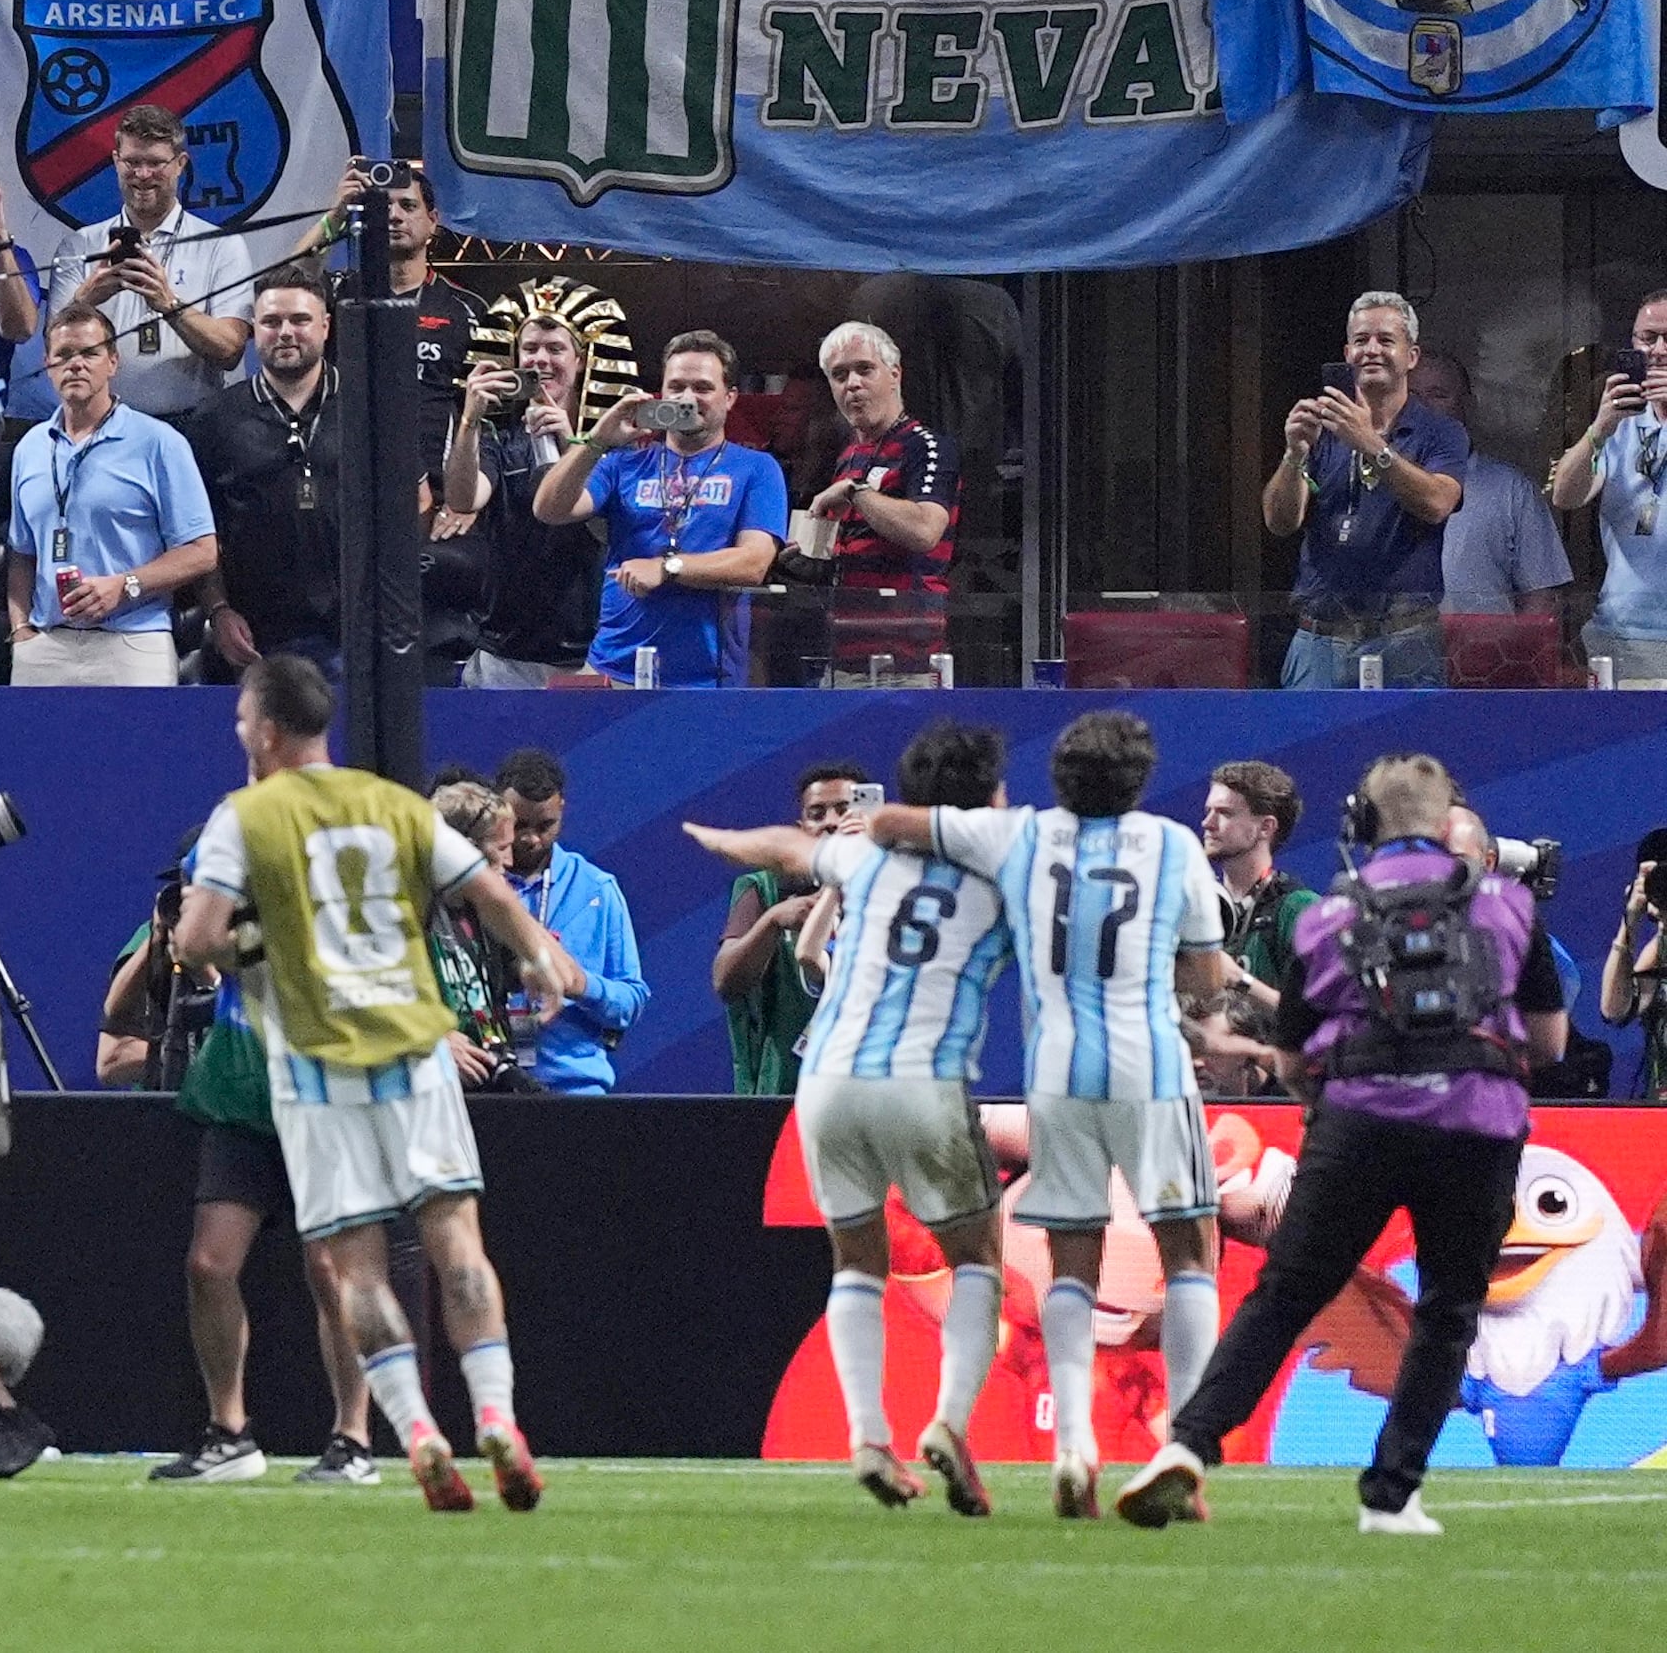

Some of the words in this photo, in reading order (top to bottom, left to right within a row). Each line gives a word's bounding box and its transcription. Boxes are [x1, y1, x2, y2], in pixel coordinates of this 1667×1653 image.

[765, 0, 1225, 130] NEVA
[887, 884, 958, 969] 6
[1047, 861, 1141, 980] 17
